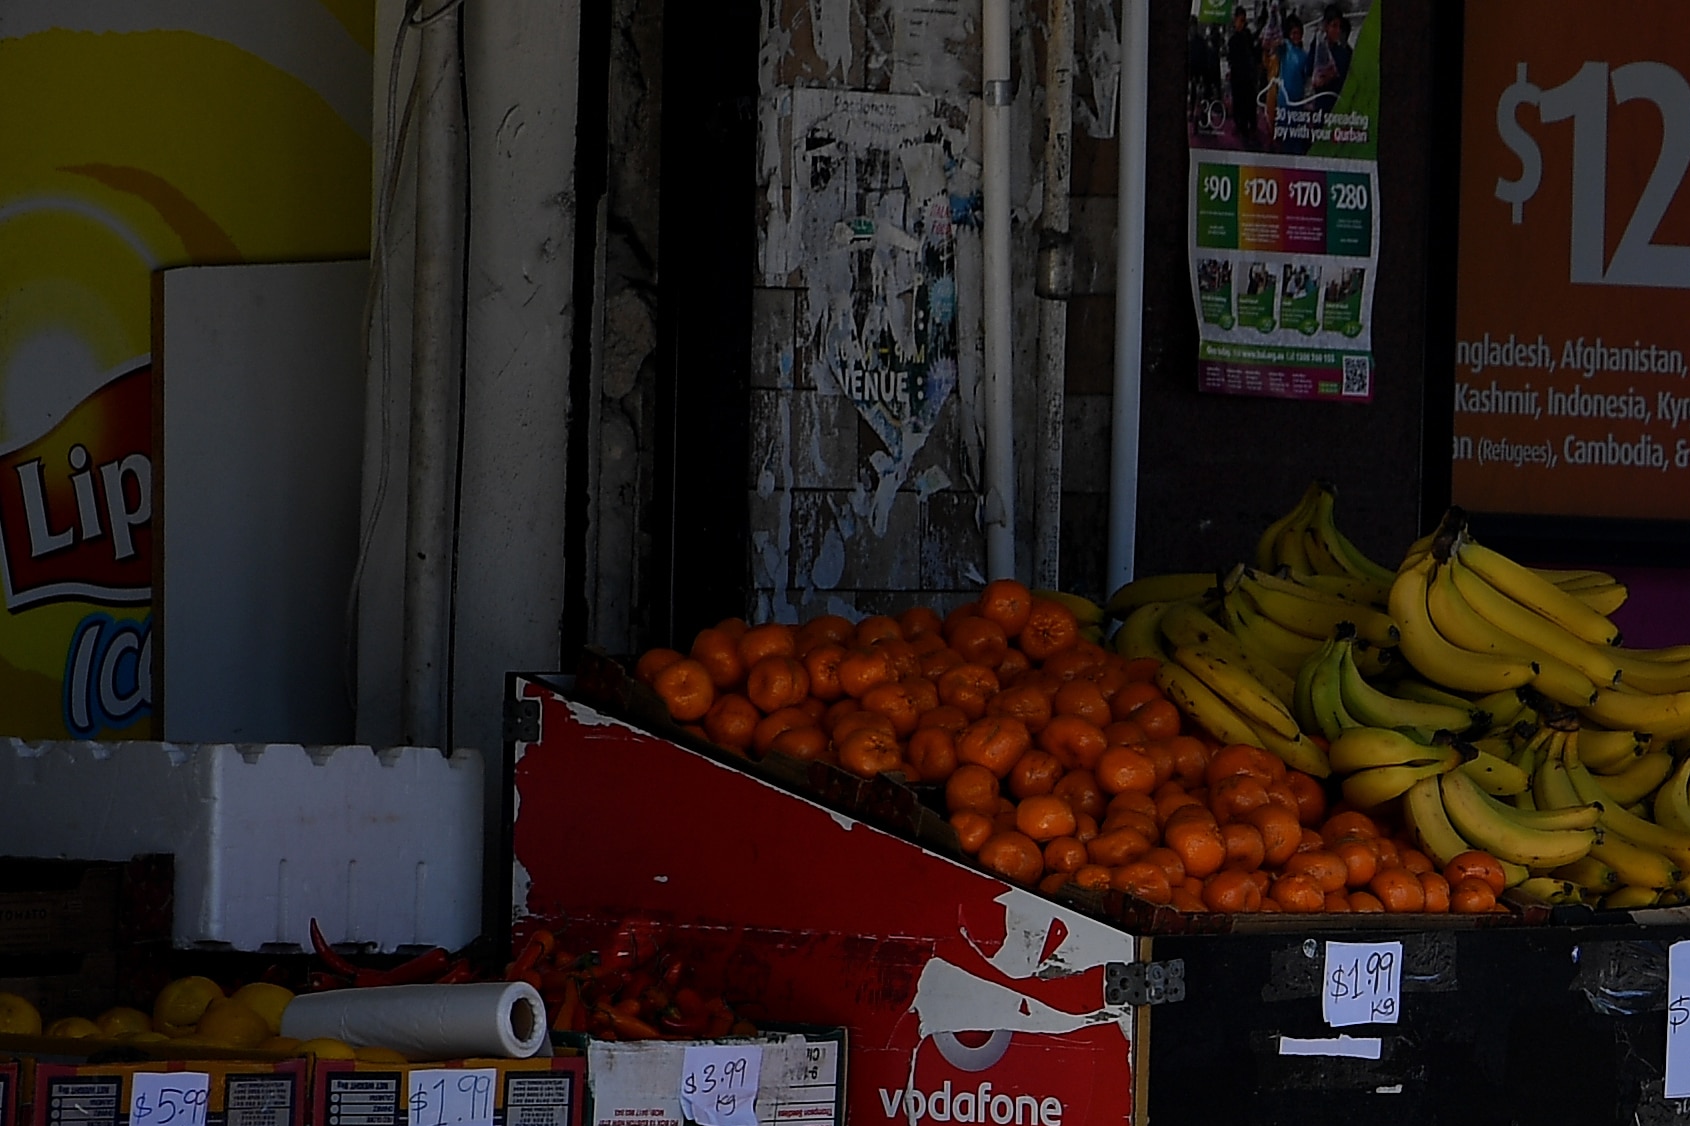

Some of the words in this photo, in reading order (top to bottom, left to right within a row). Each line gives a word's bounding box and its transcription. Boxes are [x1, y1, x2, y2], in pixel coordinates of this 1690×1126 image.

[1204, 175, 1231, 203] $90
[1244, 178, 1279, 206] $120
[1288, 180, 1322, 208] $170
[1331, 183, 1368, 211] $280
[1560, 337, 1688, 380] Afghanistan,
[1454, 381, 1542, 420] Kashmir,
[1547, 384, 1651, 426] Indonesia,
[1478, 437, 1558, 469] (Refugees),
[1563, 433, 1669, 473] Cambodia,
[1674, 438, 1690, 469] &
[1331, 952, 1394, 1004] $1.99
[684, 1058, 747, 1095] $3.99
[133, 1088, 211, 1126] $5.99
